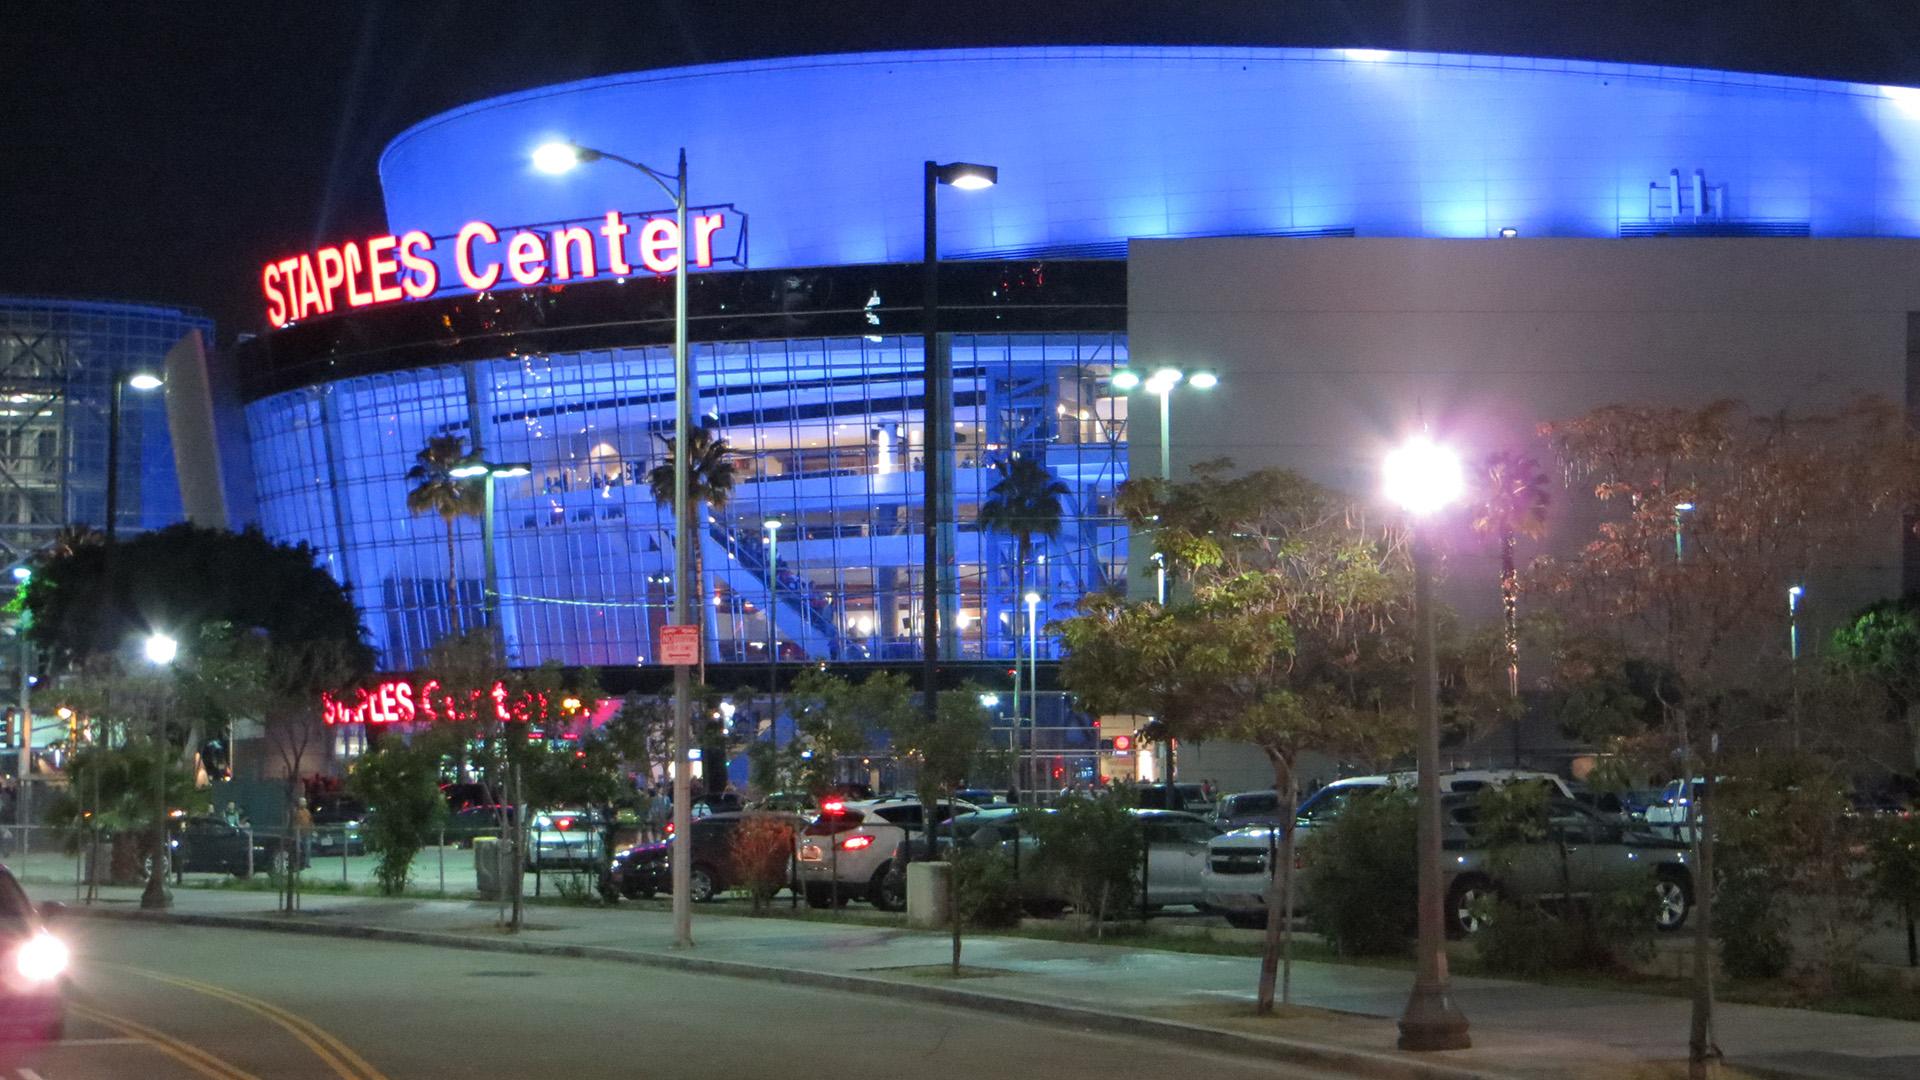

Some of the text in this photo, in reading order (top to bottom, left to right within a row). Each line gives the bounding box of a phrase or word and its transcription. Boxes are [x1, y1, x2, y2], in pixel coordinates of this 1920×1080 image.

[262, 210, 723, 328] STAPLES Center
[421, 681, 548, 721] Cte
